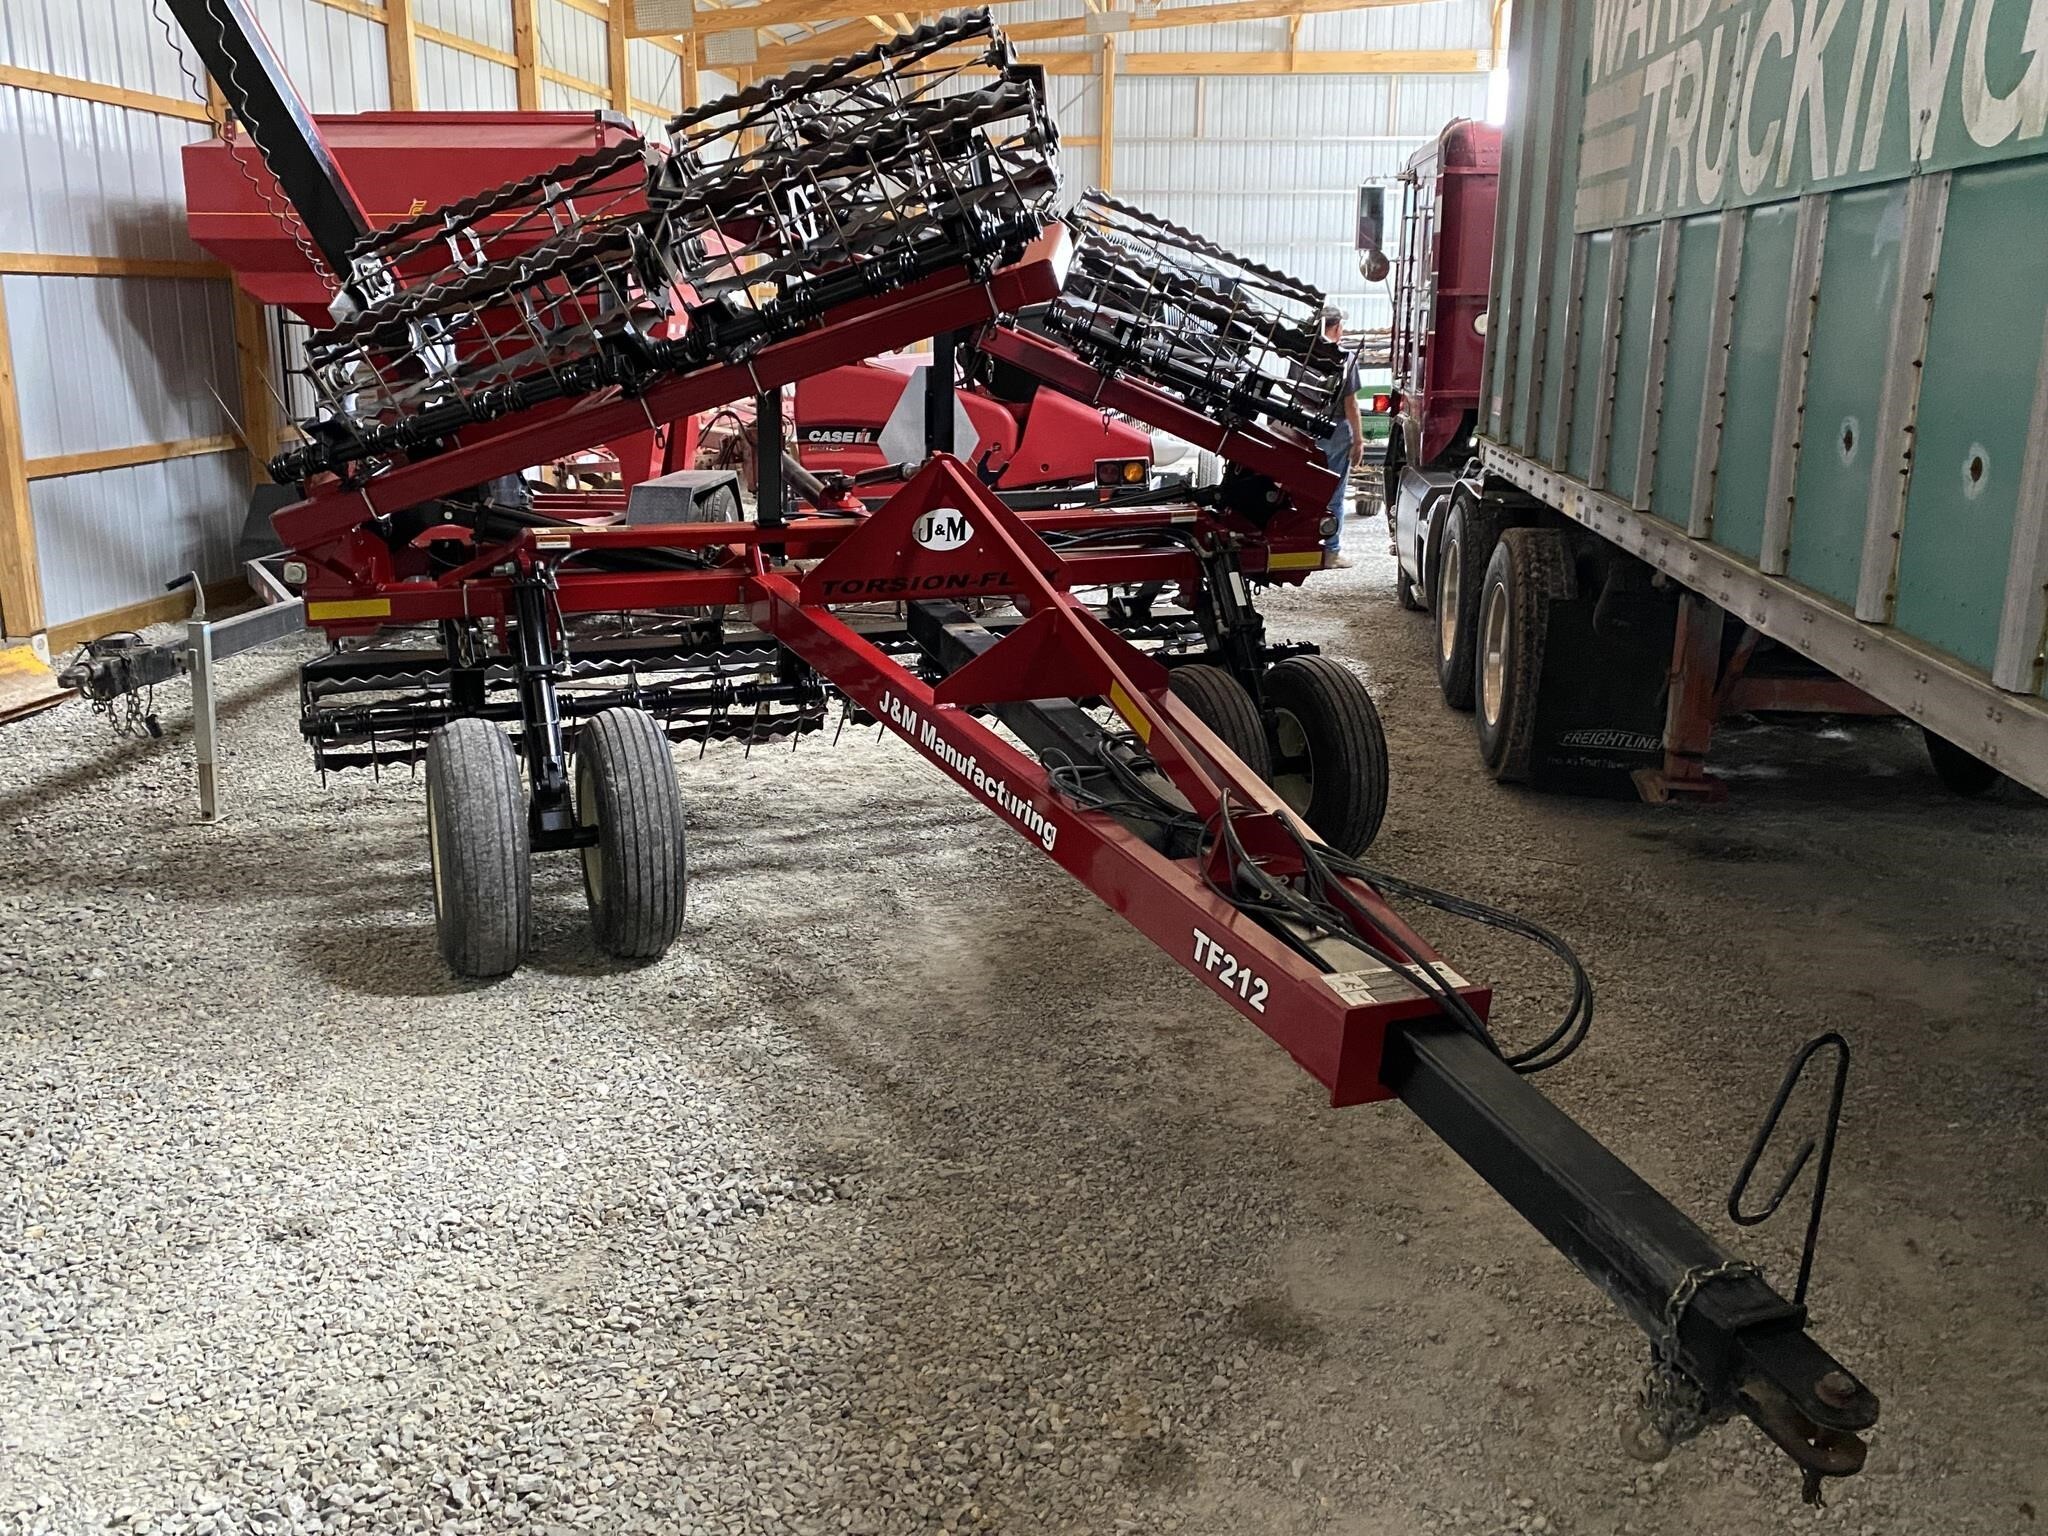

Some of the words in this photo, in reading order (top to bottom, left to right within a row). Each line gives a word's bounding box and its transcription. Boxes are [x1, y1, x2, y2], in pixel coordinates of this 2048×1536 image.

[1636, 0, 2048, 216] TRUCKING
[808, 430, 854, 443] CASE
[918, 516, 967, 543] J&M
[879, 690, 918, 736] J&M
[920, 719, 1057, 851] Manufacturing
[1193, 927, 1269, 1013] TF212
